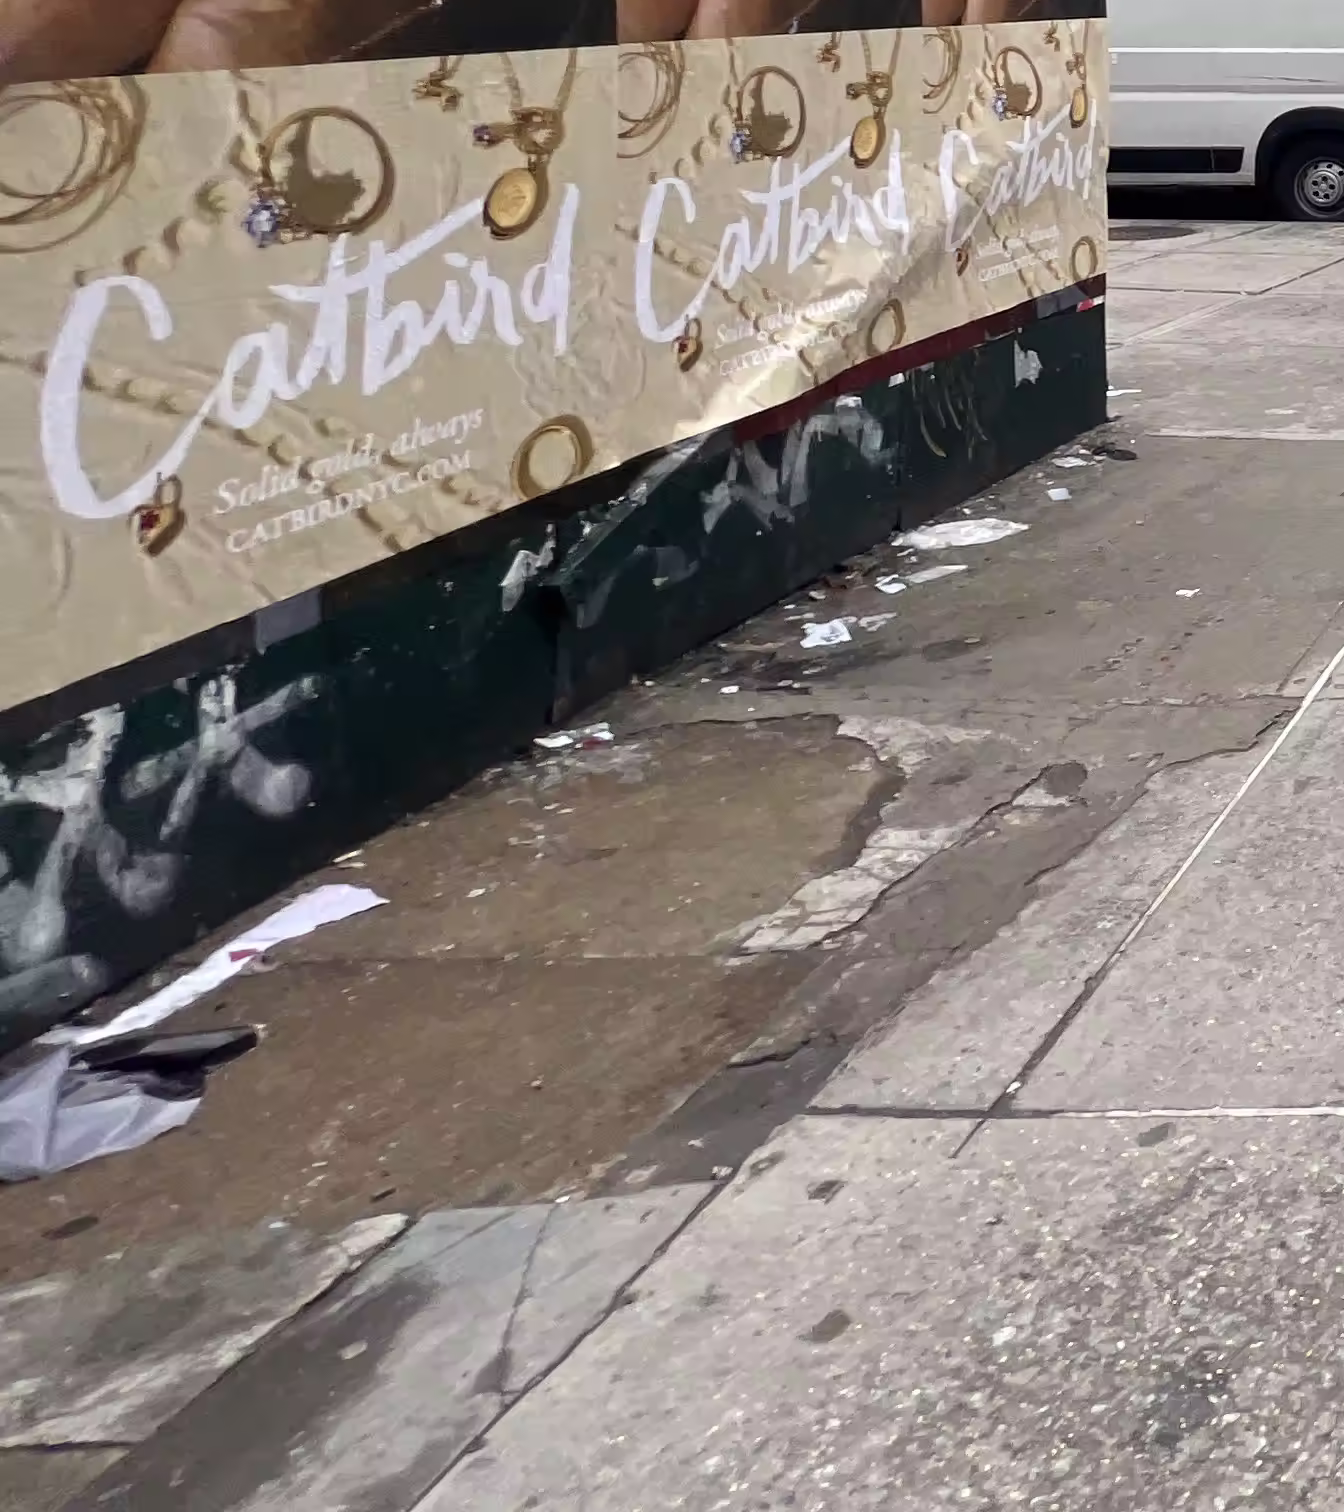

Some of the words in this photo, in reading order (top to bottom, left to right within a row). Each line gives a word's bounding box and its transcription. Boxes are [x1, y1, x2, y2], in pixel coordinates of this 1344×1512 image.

[40, 183, 580, 520] Catbird
[634, 128, 911, 343] Catbird
[938, 98, 1098, 254] Catbird
[213, 454, 301, 515] Solid
[390, 408, 484, 457] always
[225, 449, 472, 554] CATBIRDNYC.COM
